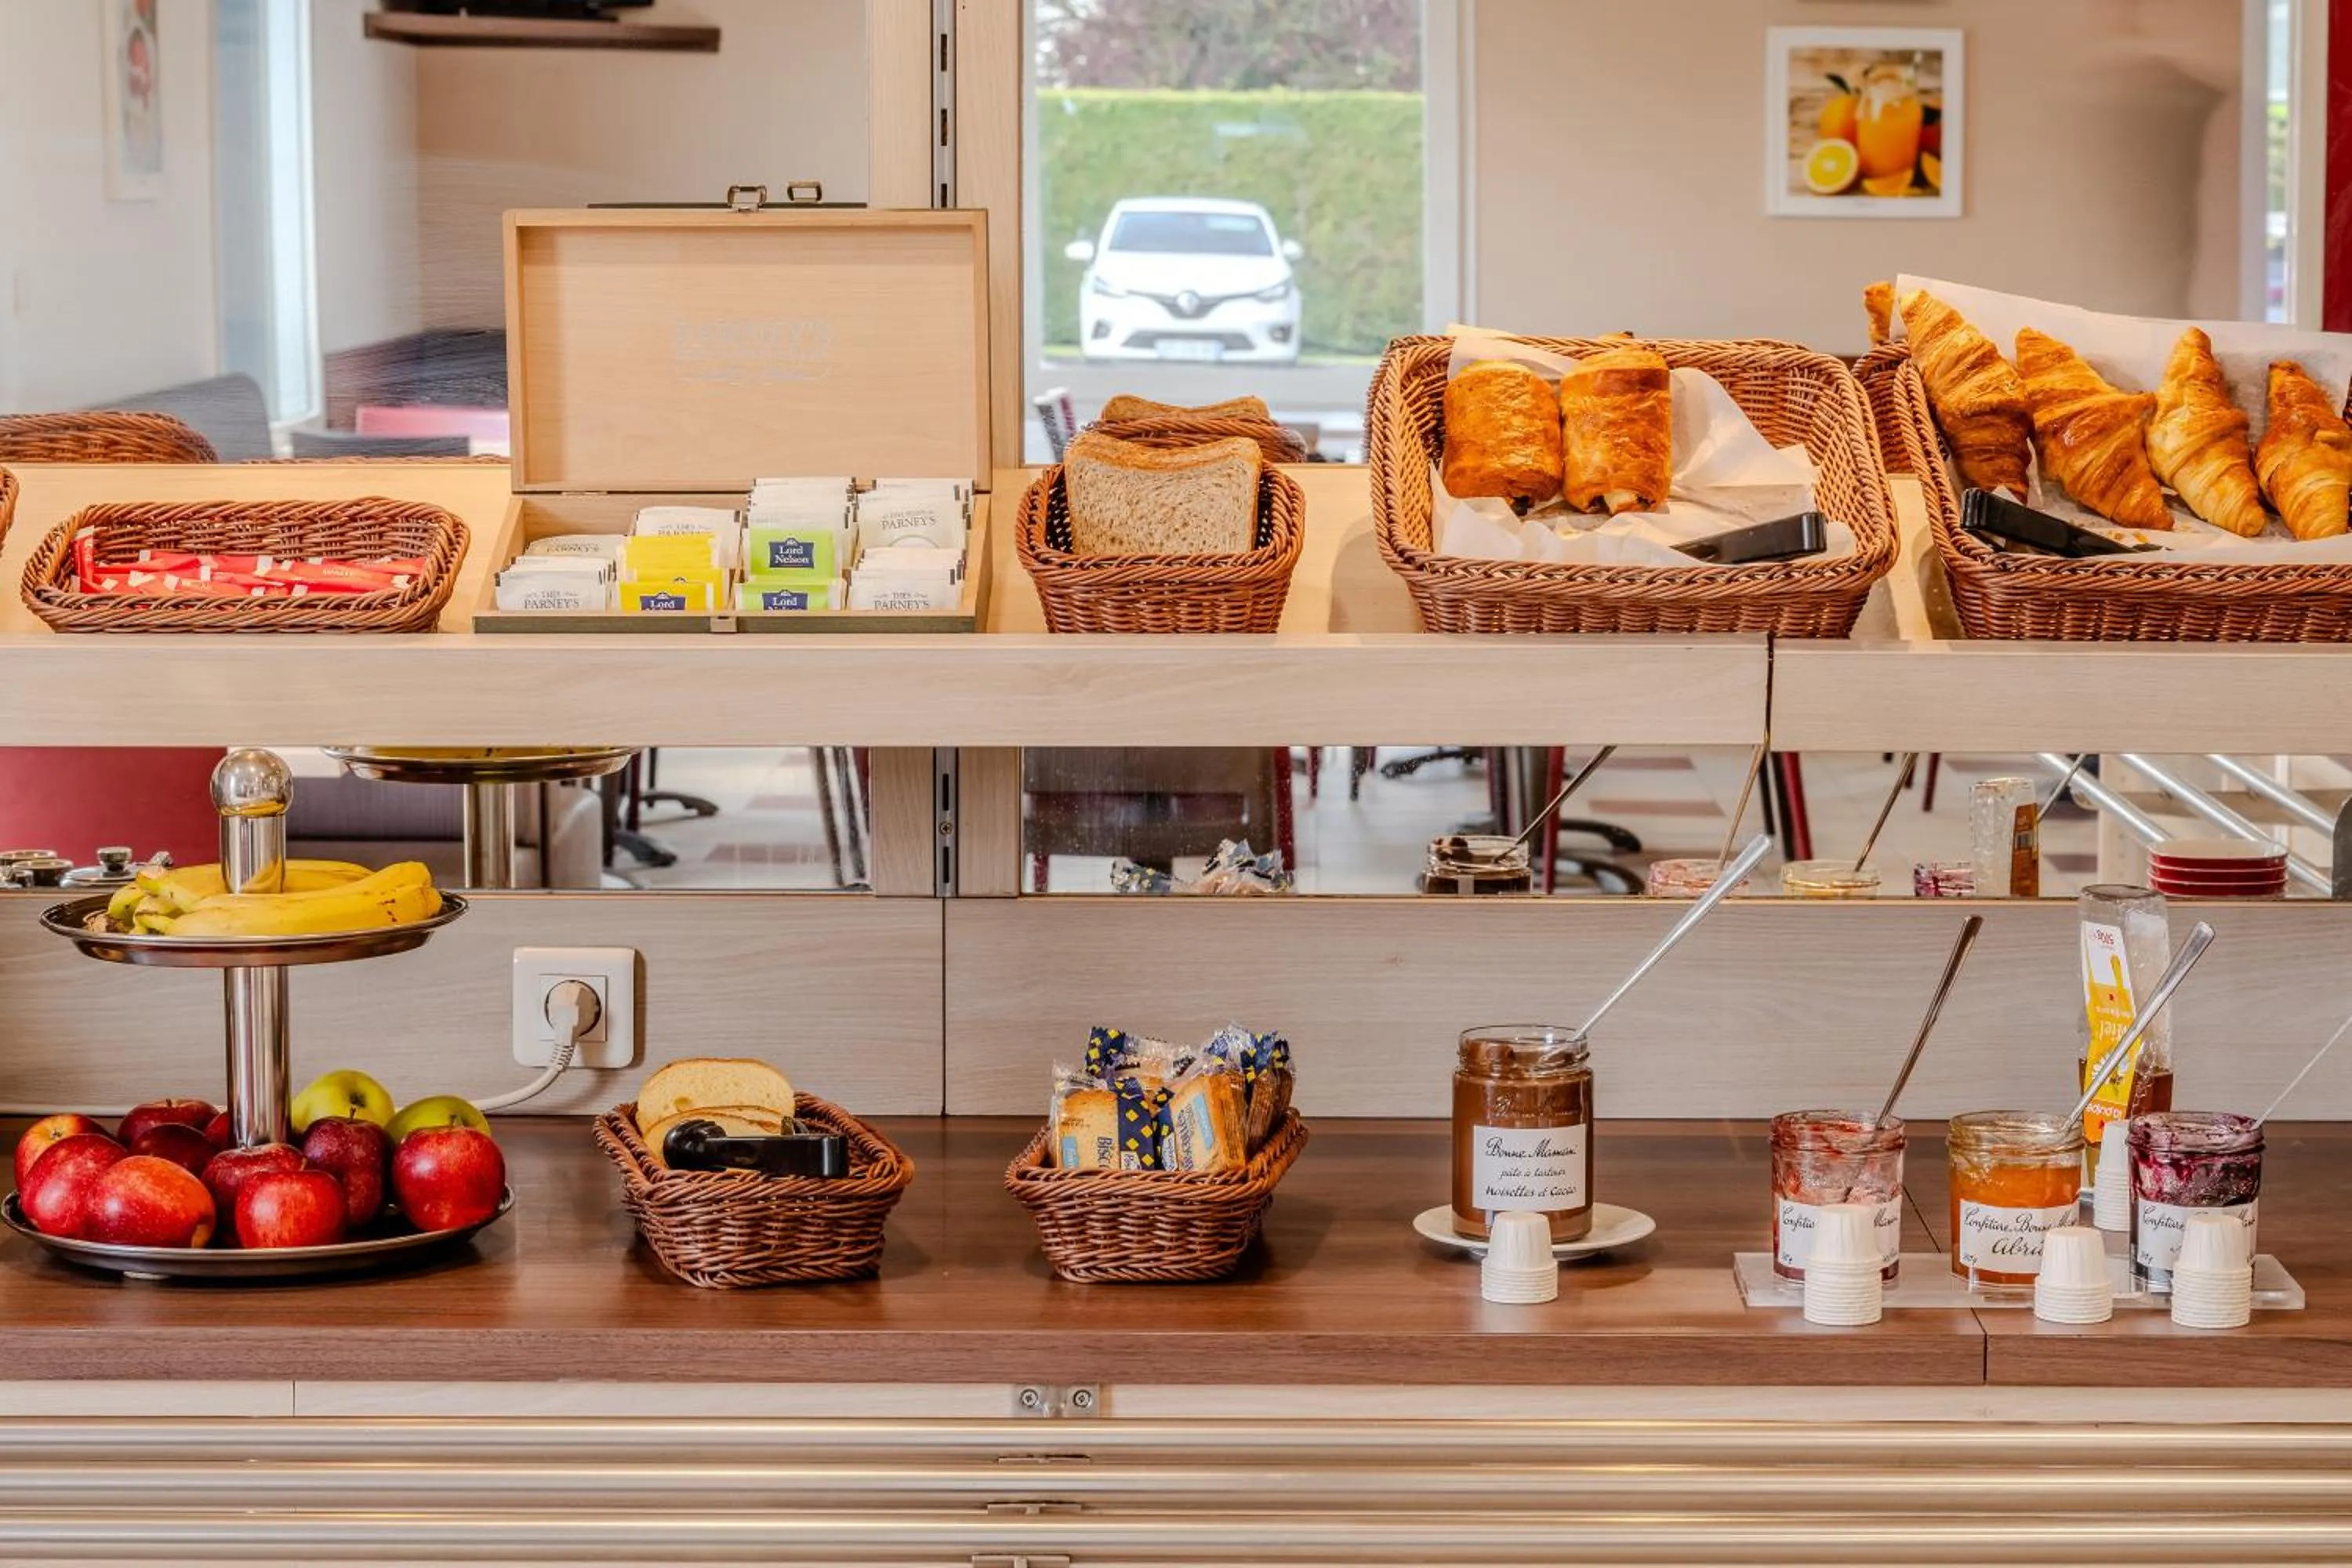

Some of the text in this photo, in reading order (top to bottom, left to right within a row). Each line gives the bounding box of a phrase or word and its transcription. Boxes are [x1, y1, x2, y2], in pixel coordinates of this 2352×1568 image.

[779, 546, 804, 555] Lord
[775, 554, 810, 564] Nelson
[524, 598, 580, 609] PARNEY'S
[650, 600, 675, 609] Lord
[772, 597, 797, 607] Lord
[873, 600, 930, 610] PARNEY'S
[1485, 1136, 1577, 1158] Bonne Maman
